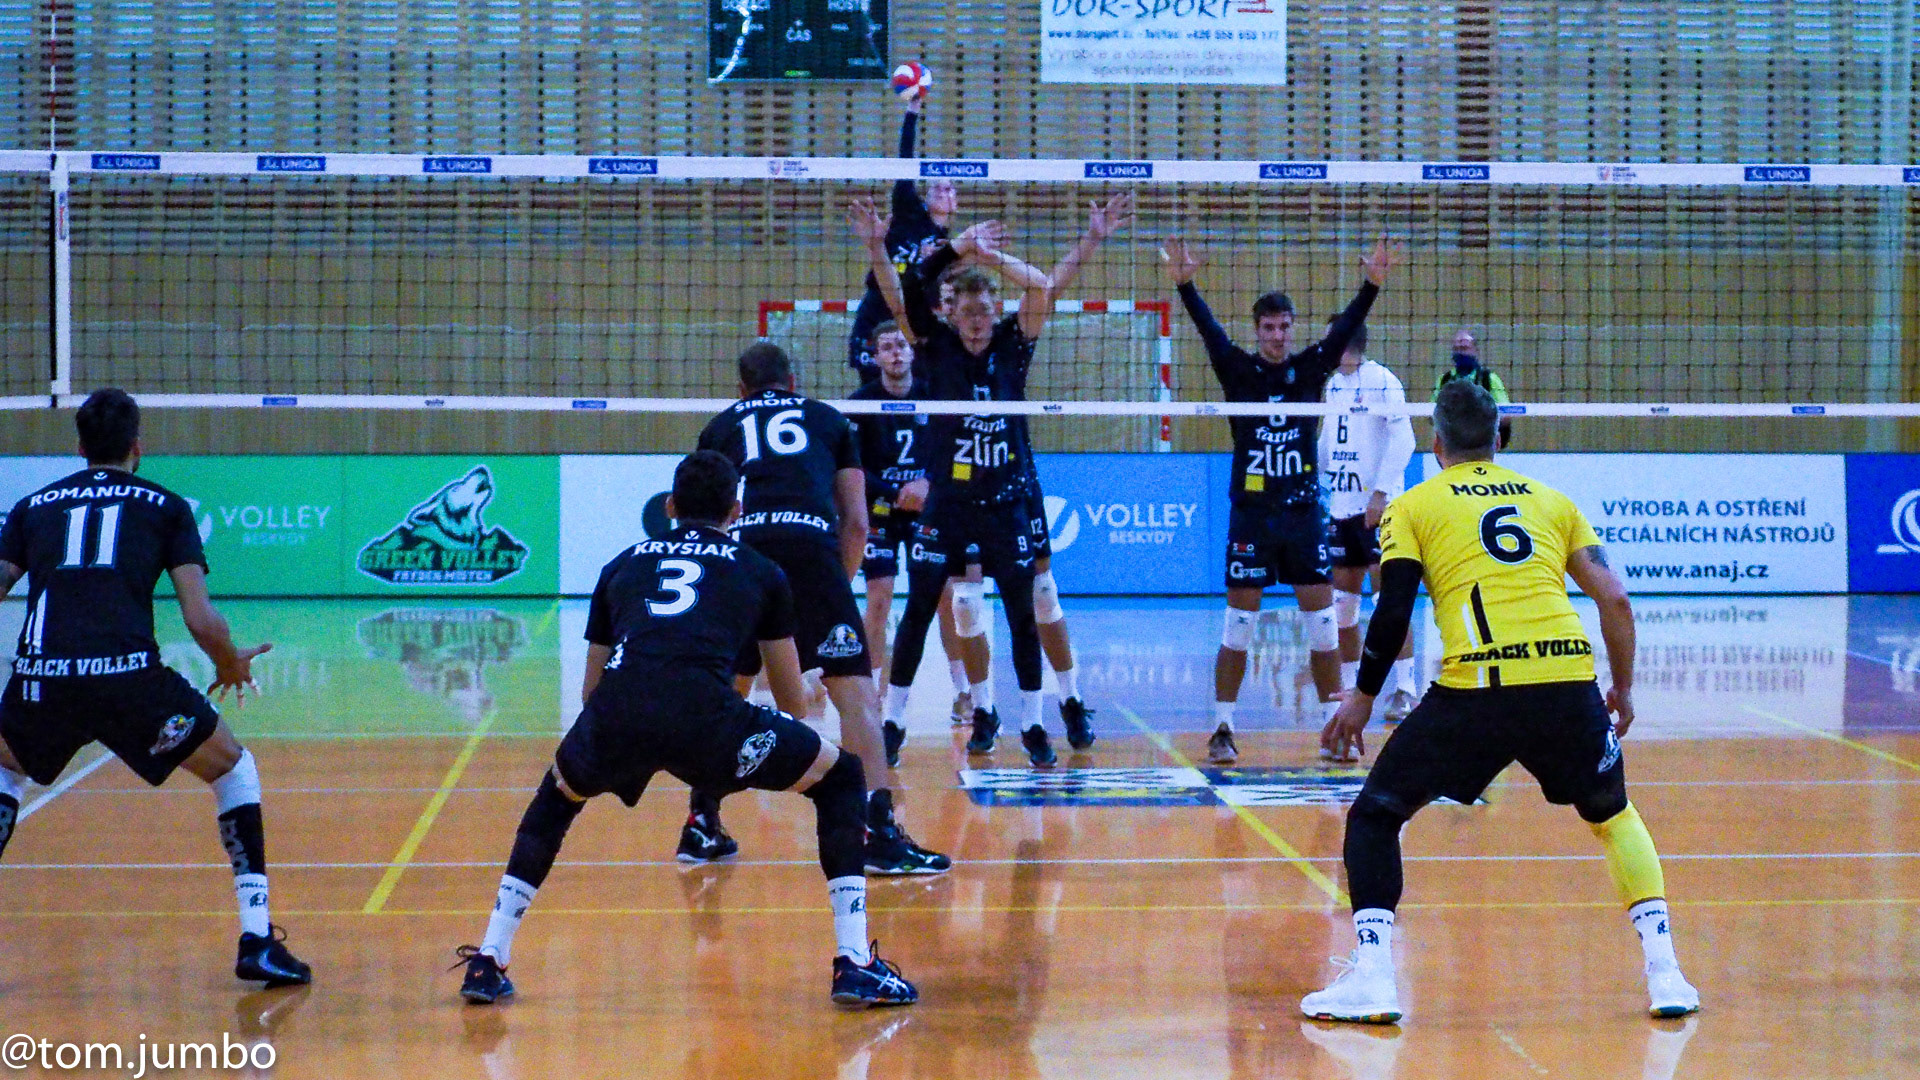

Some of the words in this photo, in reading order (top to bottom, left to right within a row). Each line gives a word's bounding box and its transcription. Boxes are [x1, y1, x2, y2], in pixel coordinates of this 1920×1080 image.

[785, 19, 813, 42] ČAS
[116, 156, 156, 168] UNIQA
[281, 158, 321, 170] UNIQA
[450, 160, 487, 171] UNIQA
[614, 161, 652, 172] UNIQA
[944, 164, 984, 176] UNIQA
[1108, 165, 1148, 177] UNIQA
[1284, 166, 1323, 177] UNIQA
[1446, 168, 1485, 179] UNIQA
[1767, 168, 1806, 180] UNIQA
[740, 409, 808, 462] 16
[896, 429, 915, 464] 2
[953, 432, 1009, 467] zlín
[1246, 444, 1303, 477] zlín
[28, 484, 167, 509] ROMANUTTI
[1449, 480, 1533, 497] MONÍK
[218, 505, 332, 528] VOLLEY
[1084, 502, 1199, 528] VOLLEY
[1602, 496, 1690, 516] VÝROBA
[1695, 500, 1711, 516] A
[1716, 496, 1807, 517] OSTŘENÍ
[771, 510, 831, 532] VOLLEY
[1031, 518, 1043, 535] 12
[1592, 521, 1718, 543] PECIÁLNÍCH
[1723, 520, 1836, 543] NÁSTROJŮ
[61, 502, 123, 567] 11
[1017, 535, 1028, 552] 9
[1109, 530, 1176, 545] BESKYDY
[1479, 504, 1535, 565] 6
[361, 548, 435, 569] GREEN
[441, 548, 528, 569] VOLLEY
[631, 540, 739, 561] KRYSIAK
[1318, 543, 1328, 561] 5
[1624, 560, 1770, 583] www.anaj.cz
[645, 556, 705, 617] 3
[1534, 638, 1592, 660] VOLLE
[76, 651, 149, 675] VOLLEY
